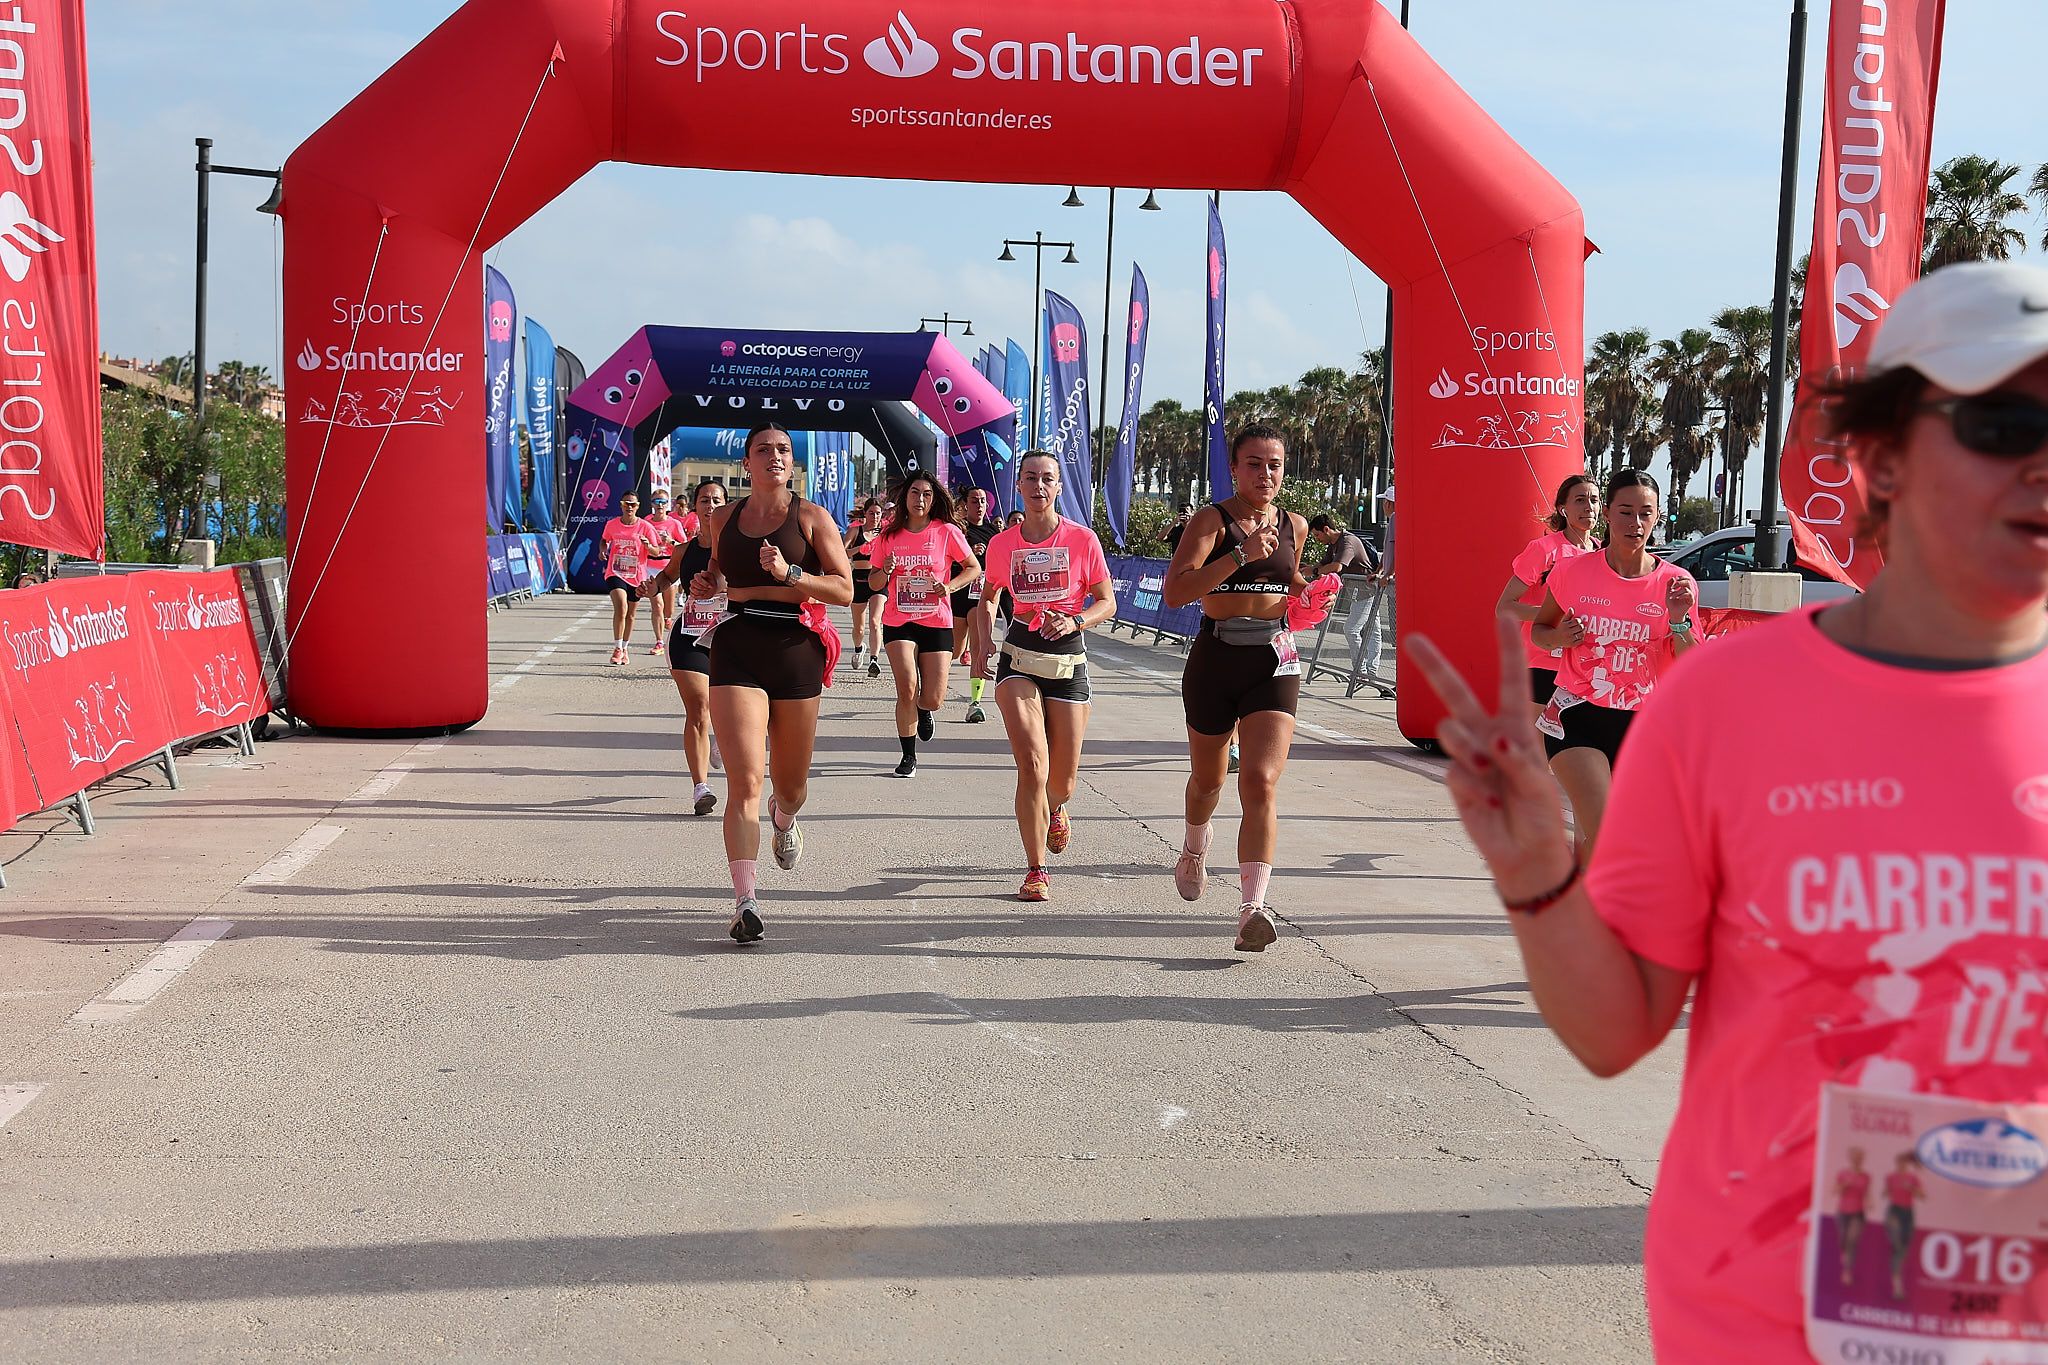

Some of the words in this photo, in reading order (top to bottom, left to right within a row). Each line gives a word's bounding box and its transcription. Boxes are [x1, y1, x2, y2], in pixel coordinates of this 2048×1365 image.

[655, 10, 849, 83] Sports
[951, 28, 1263, 87] Santander
[850, 105, 1053, 130] sportssantander.es
[332, 297, 424, 330] Sports
[742, 343, 807, 359] octopus
[808, 344, 864, 363] energy
[1473, 326, 1555, 356] Sports
[325, 345, 464, 372] Santander
[710, 364, 726, 374] LA
[729, 363, 781, 376] ENERGÍA
[784, 367, 816, 377] PARA
[820, 368, 869, 379] CORRER
[708, 377, 718, 386] A
[720, 377, 736, 386] LA
[739, 378, 808, 389] VELOCIDAD
[810, 380, 826, 389] DE
[829, 381, 844, 390] LA
[847, 381, 871, 390] LUZ
[1464, 371, 1580, 397] Santander
[693, 394, 846, 412] VOLVO
[1027, 572, 1051, 583] 016
[1233, 583, 1263, 592] NIKE
[1263, 584, 1283, 593] PRO
[910, 591, 927, 599] 016
[1580, 595, 1611, 607] OYSHO
[148, 590, 189, 641] Sports
[695, 612, 714, 620] 016
[4, 619, 51, 683] Sports
[62, 599, 129, 653] Santander
[1767, 777, 1904, 816] OYSHO
[1920, 1232, 2034, 1285] 016
